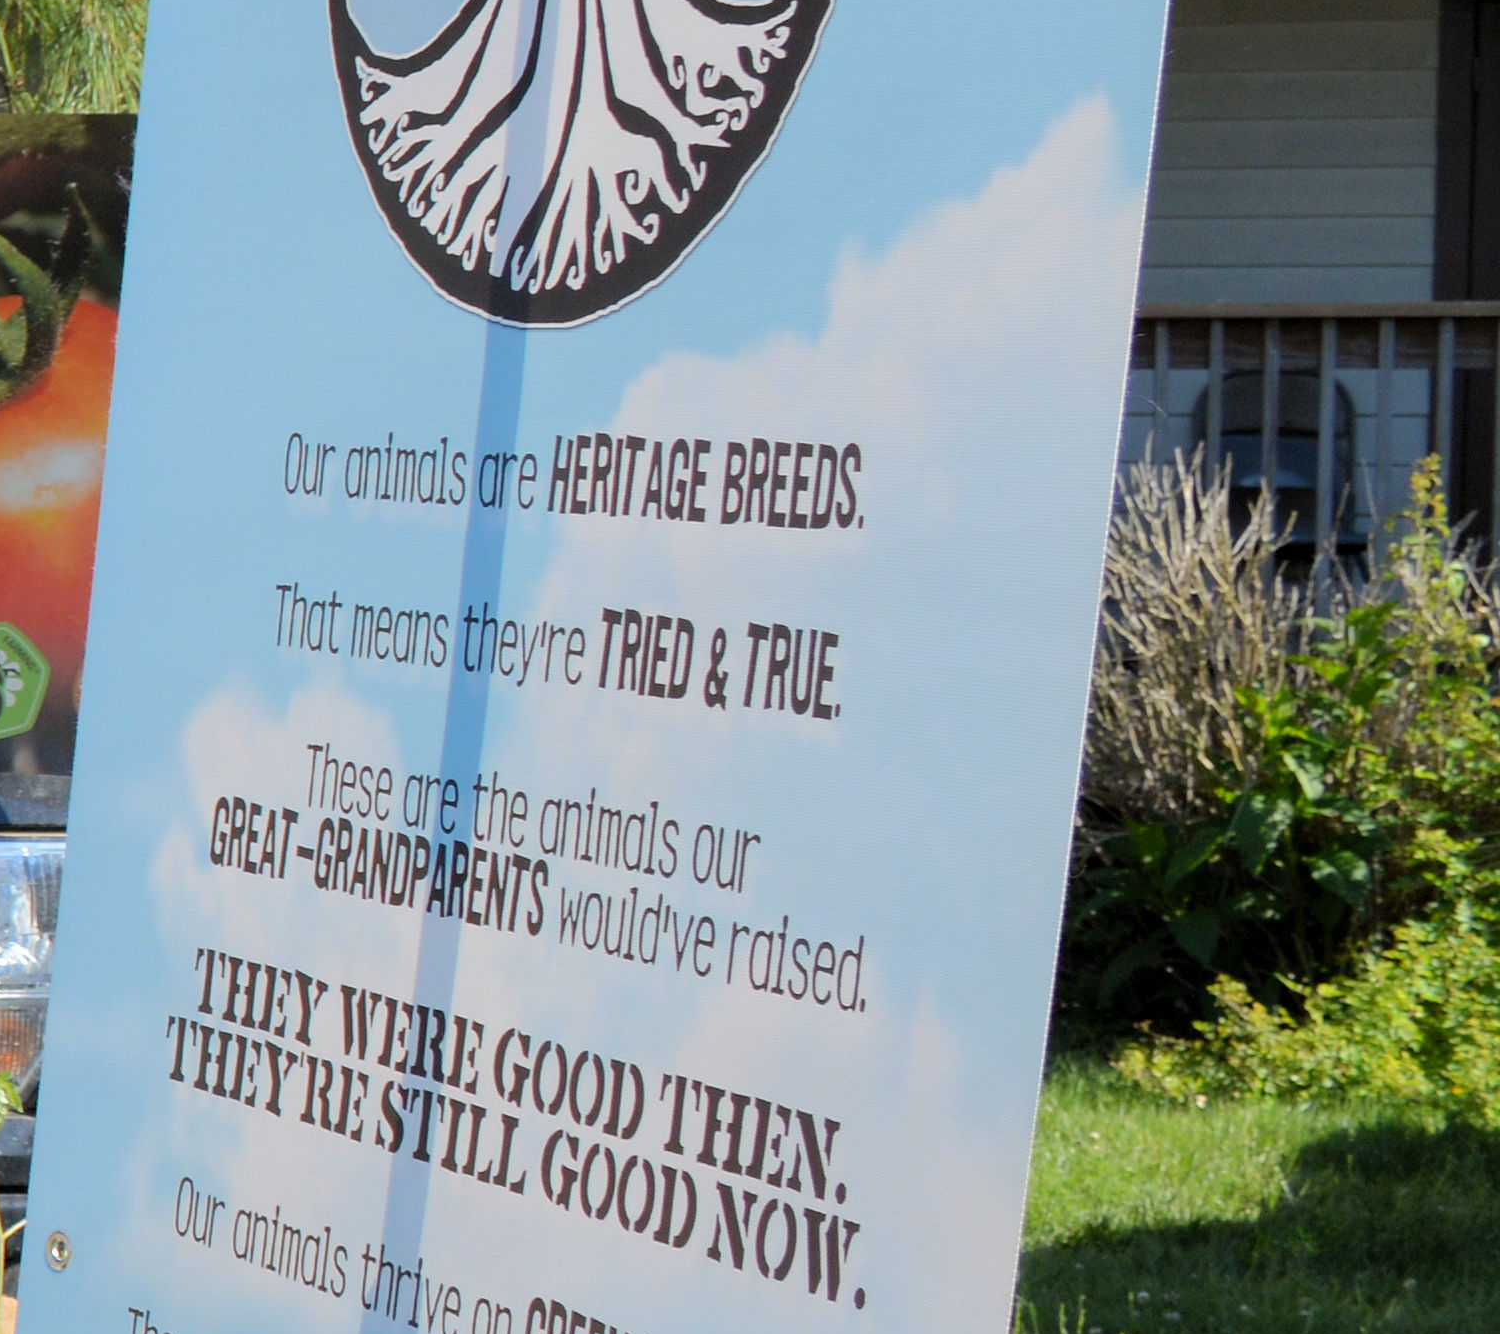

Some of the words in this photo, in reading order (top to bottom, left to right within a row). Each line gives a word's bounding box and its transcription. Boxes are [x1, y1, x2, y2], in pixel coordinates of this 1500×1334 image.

[285, 432, 336, 498] Our
[344, 431, 466, 506] animals
[477, 449, 538, 510] are
[547, 433, 711, 523] HERITAGE
[720, 437, 864, 530] BREEDS.
[275, 582, 343, 653] That
[350, 593, 448, 667] means
[462, 601, 586, 687] they're
[599, 607, 694, 700] TRIED
[702, 627, 728, 711] &
[742, 622, 840, 720] TRUE.
[306, 743, 393, 821] These
[402, 771, 459, 835] are
[472, 771, 528, 847] the
[540, 787, 680, 878] animals
[692, 821, 761, 893] our
[210, 796, 549, 937] GREAT-GRANDPARENTS
[558, 884, 716, 977] would've
[726, 914, 867, 1012] raised.
[194, 947, 329, 1046] THEY
[340, 983, 484, 1095] WERE
[492, 1028, 646, 1142] GOOD
[660, 1071, 848, 1205] THEN.
[166, 1015, 369, 1145] THEY'RE
[376, 1079, 529, 1196] STILL
[541, 1128, 698, 1249] GOOD
[706, 1181, 866, 1310] NOW.
[175, 1177, 225, 1248] Our
[232, 1204, 348, 1298] animals
